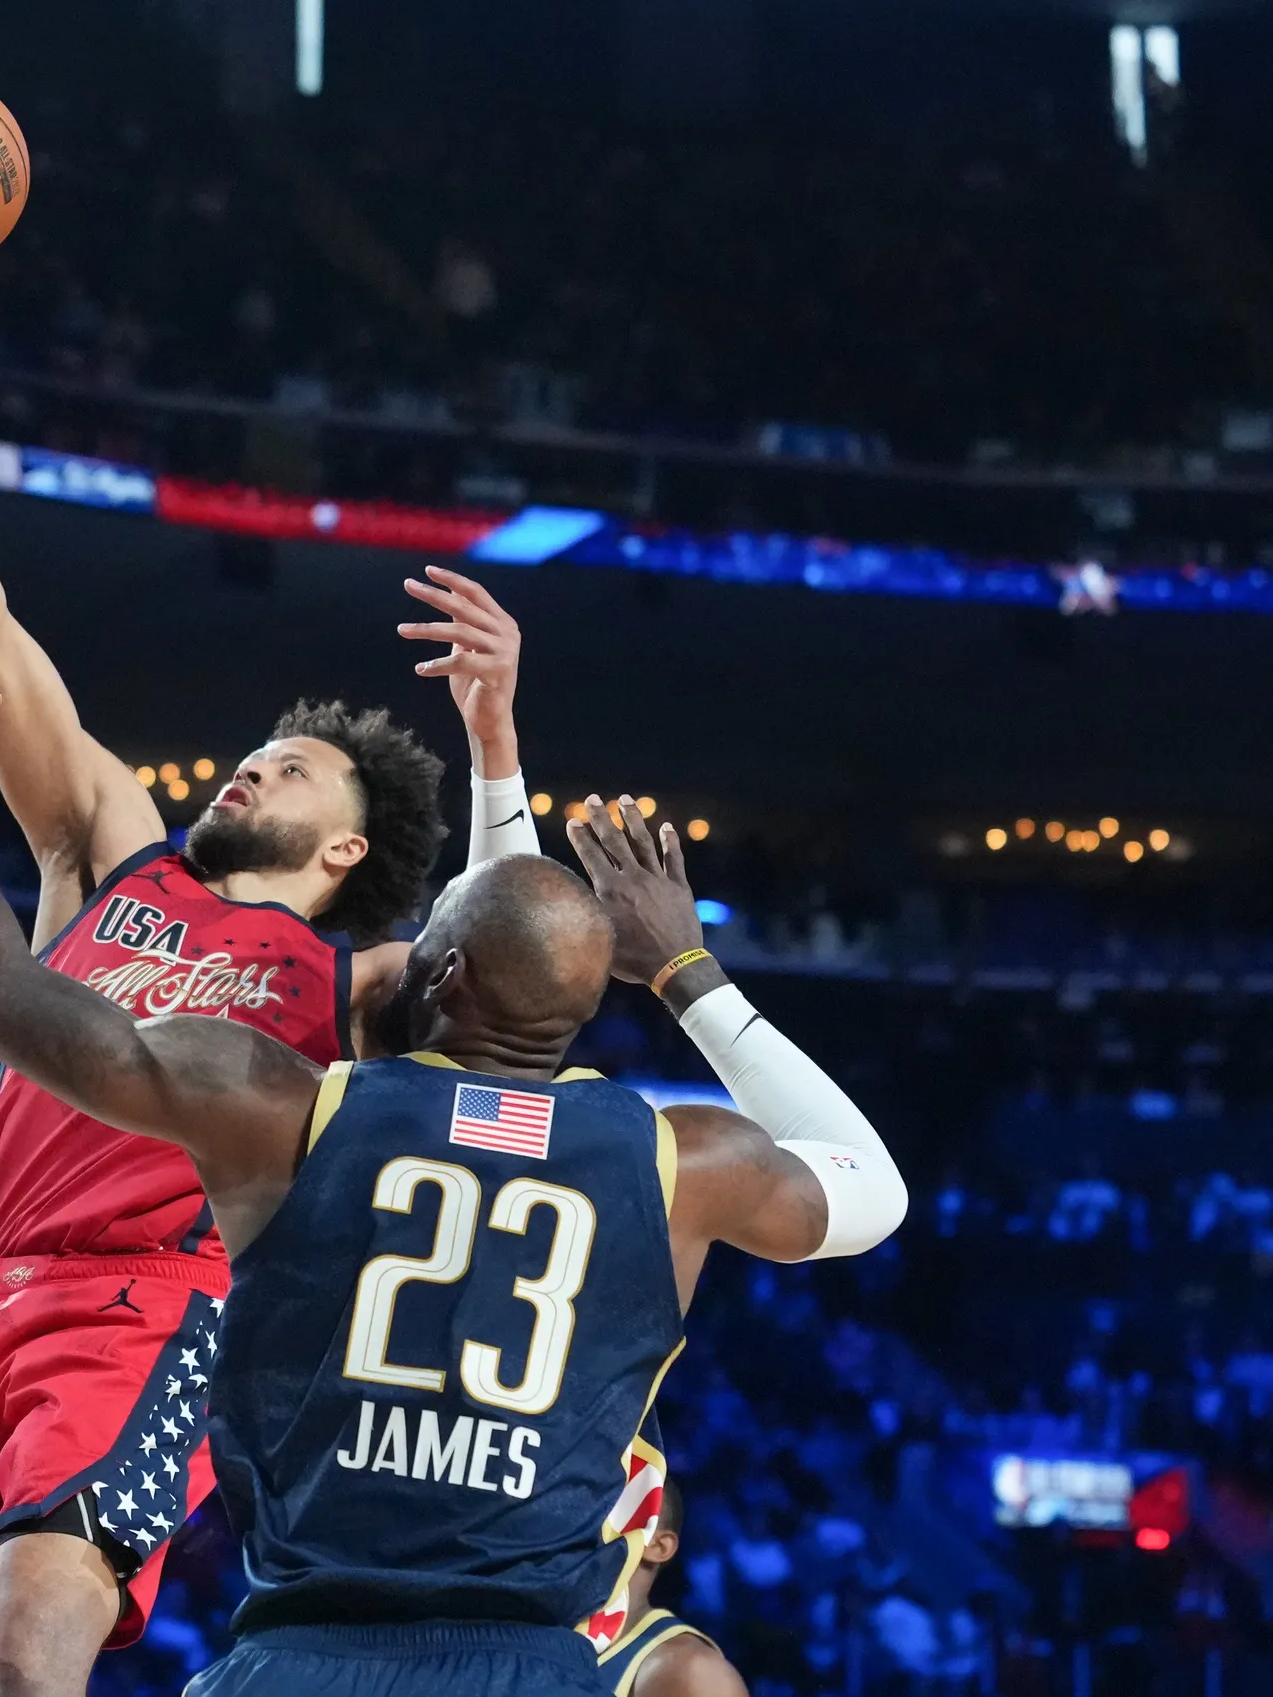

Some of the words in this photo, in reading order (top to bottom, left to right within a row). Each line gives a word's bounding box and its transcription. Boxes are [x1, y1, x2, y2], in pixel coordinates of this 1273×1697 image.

[93, 895, 189, 966] USA
[342, 1155, 598, 1415] 23
[337, 1400, 542, 1500] JAMES
